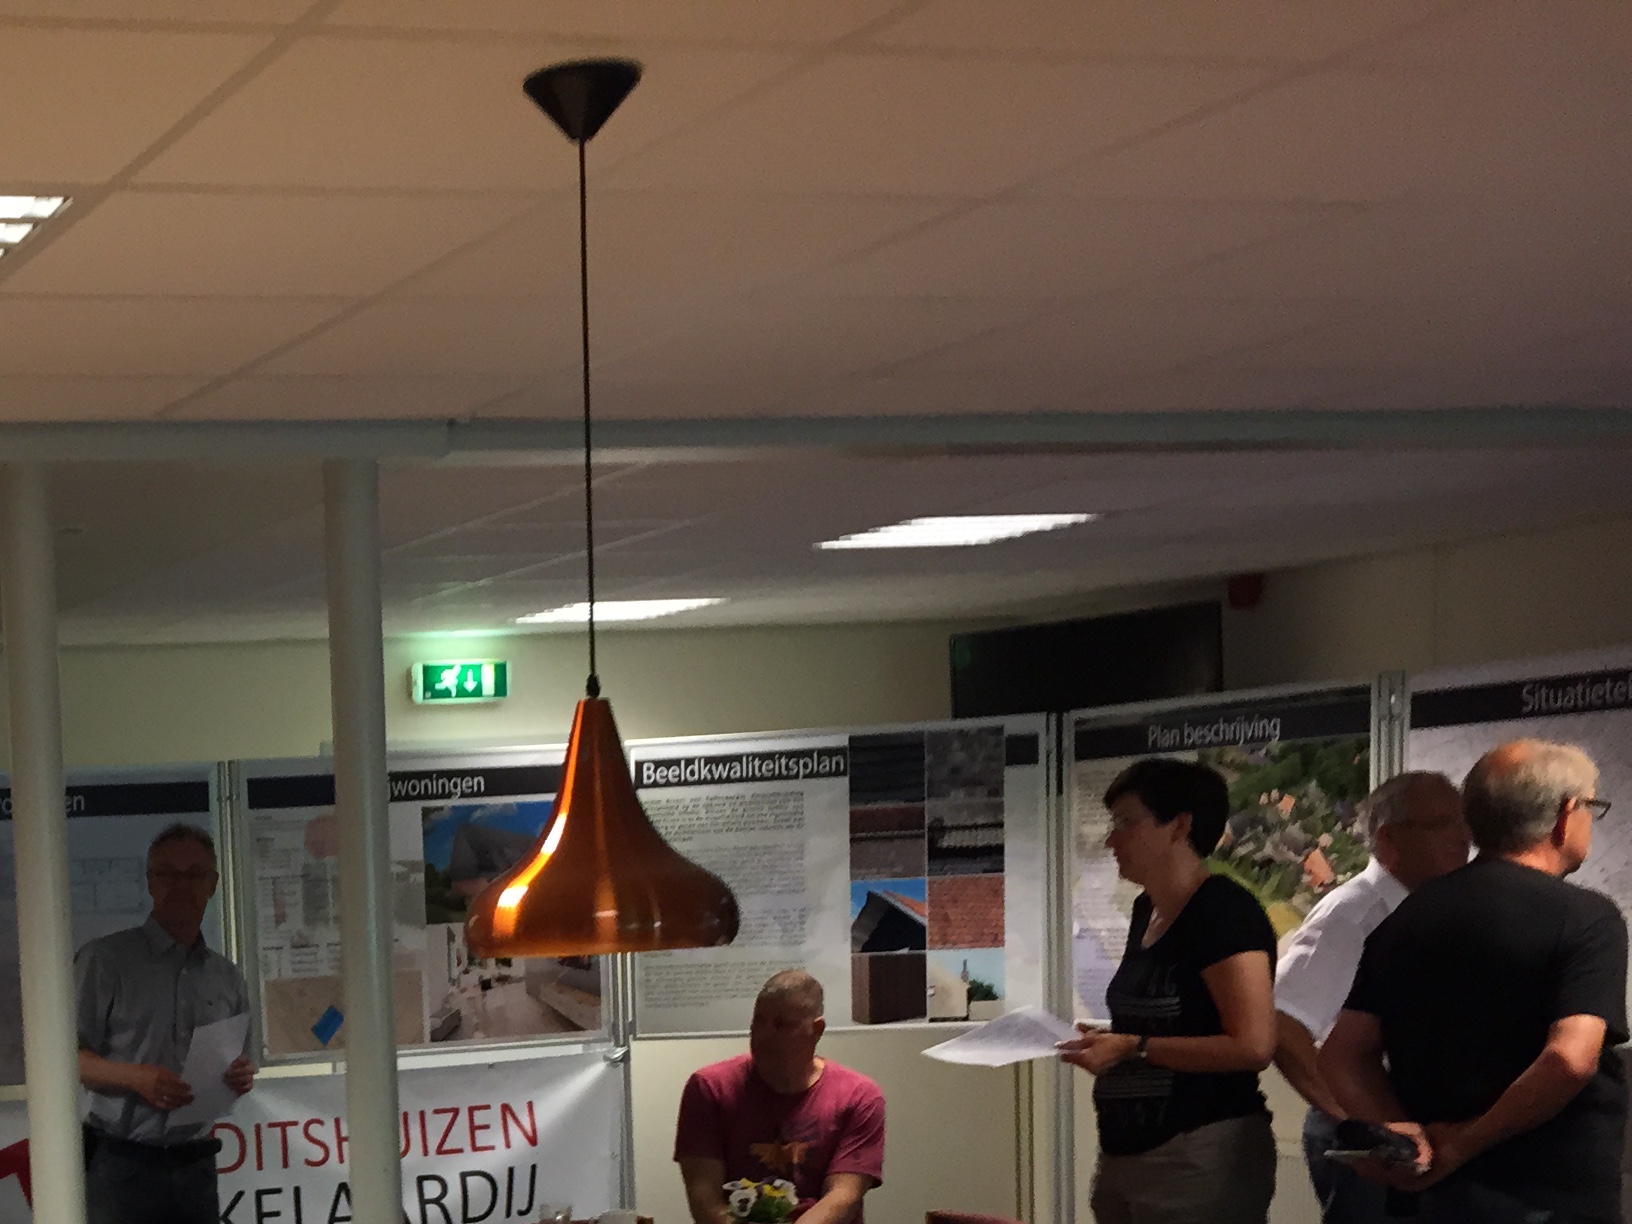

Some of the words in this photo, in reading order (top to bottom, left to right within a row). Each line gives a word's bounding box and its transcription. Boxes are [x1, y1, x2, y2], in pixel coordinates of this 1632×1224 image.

[1521, 671, 1632, 714] Situatiete
[1148, 723, 1180, 749] Plan
[1183, 713, 1281, 757] beschrijving
[388, 773, 485, 799] woningen
[642, 750, 846, 785] Beeldkwaliteitsplan
